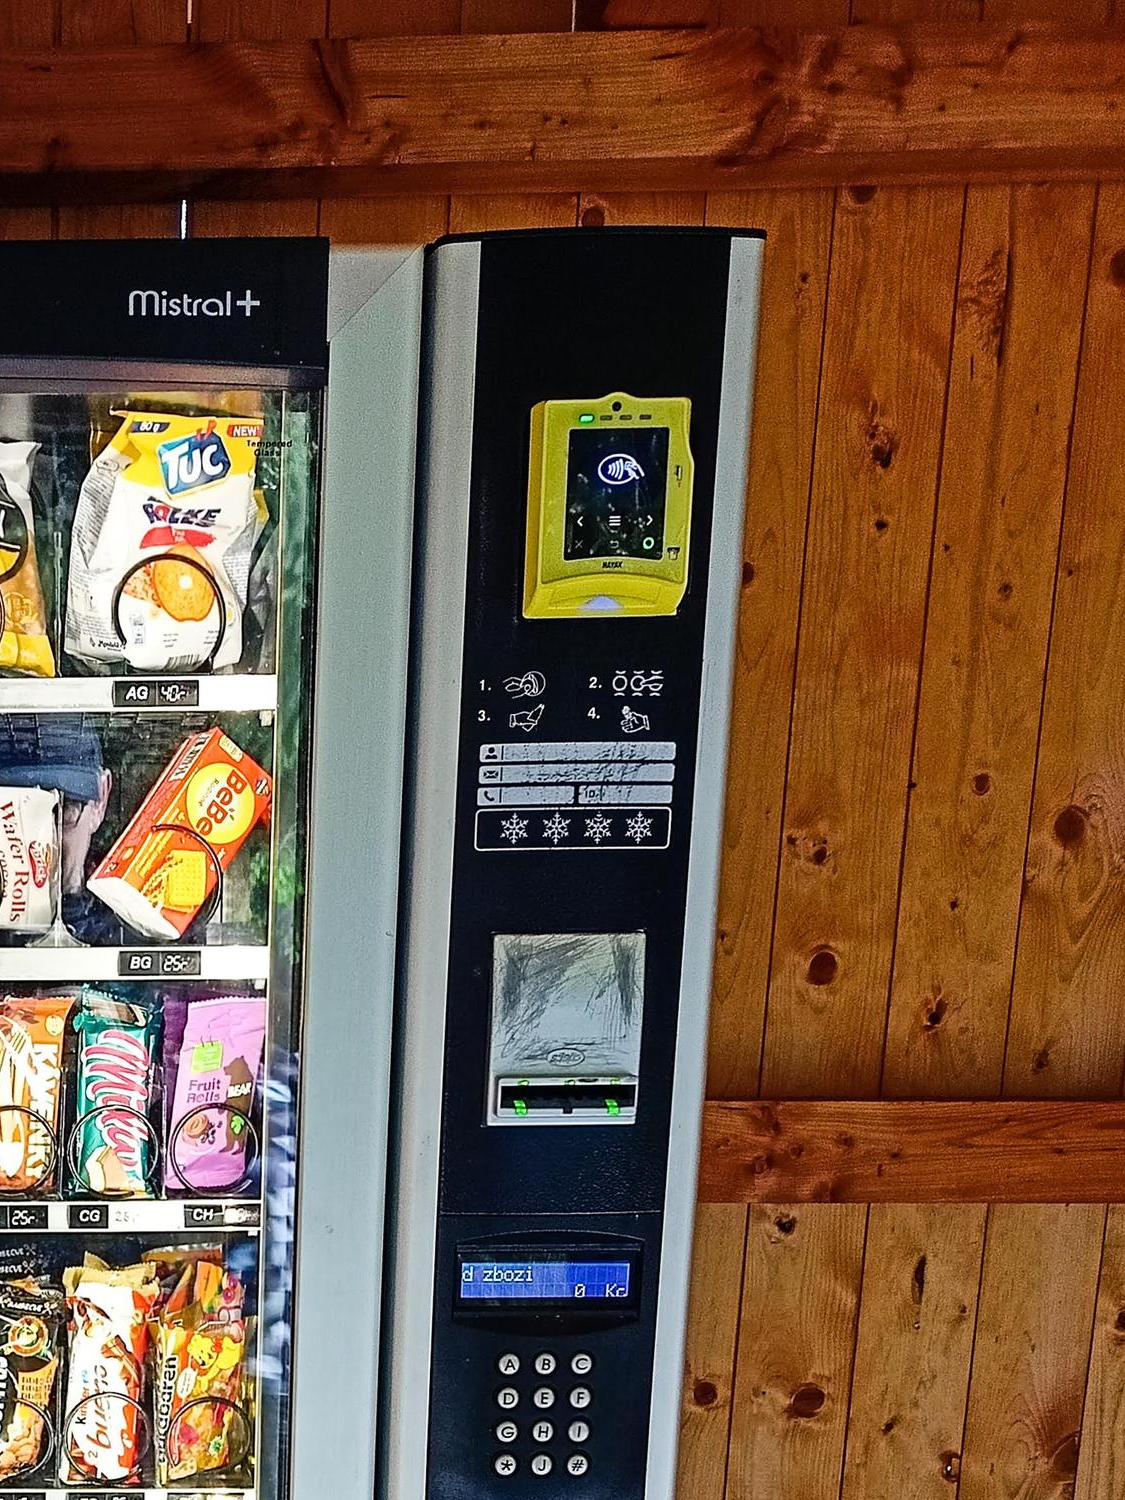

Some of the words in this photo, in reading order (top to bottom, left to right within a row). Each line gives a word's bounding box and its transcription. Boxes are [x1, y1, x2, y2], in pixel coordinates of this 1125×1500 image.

[129, 290, 260, 316] Mistral+
[246, 440, 292, 448] Tempered
[160, 440, 224, 490] TUC
[479, 679, 492, 691] 1.
[588, 677, 602, 689] 2.
[125, 686, 148, 700] AG
[478, 710, 491, 721] 3.
[587, 707, 601, 719] 4.
[196, 768, 248, 836] BeBe
[0, 801, 25, 864] Wafer
[10, 871, 29, 923] Rolls
[129, 956, 152, 969] BG
[189, 1077, 221, 1091] Fruit
[228, 1082, 252, 1098] BEAR
[187, 1091, 221, 1104] Rolls
[79, 1209, 100, 1222] CG
[462, 1267, 473, 1281] d
[483, 1268, 533, 1282] zbozi
[504, 1359, 516, 1371] A
[541, 1359, 551, 1370] B
[575, 1358, 589, 1370] C
[503, 1392, 515, 1405] D
[541, 1392, 549, 1405] E
[576, 1392, 585, 1404] F
[501, 1427, 514, 1438] G
[538, 1426, 549, 1438] H
[538, 1460, 546, 1471] J
